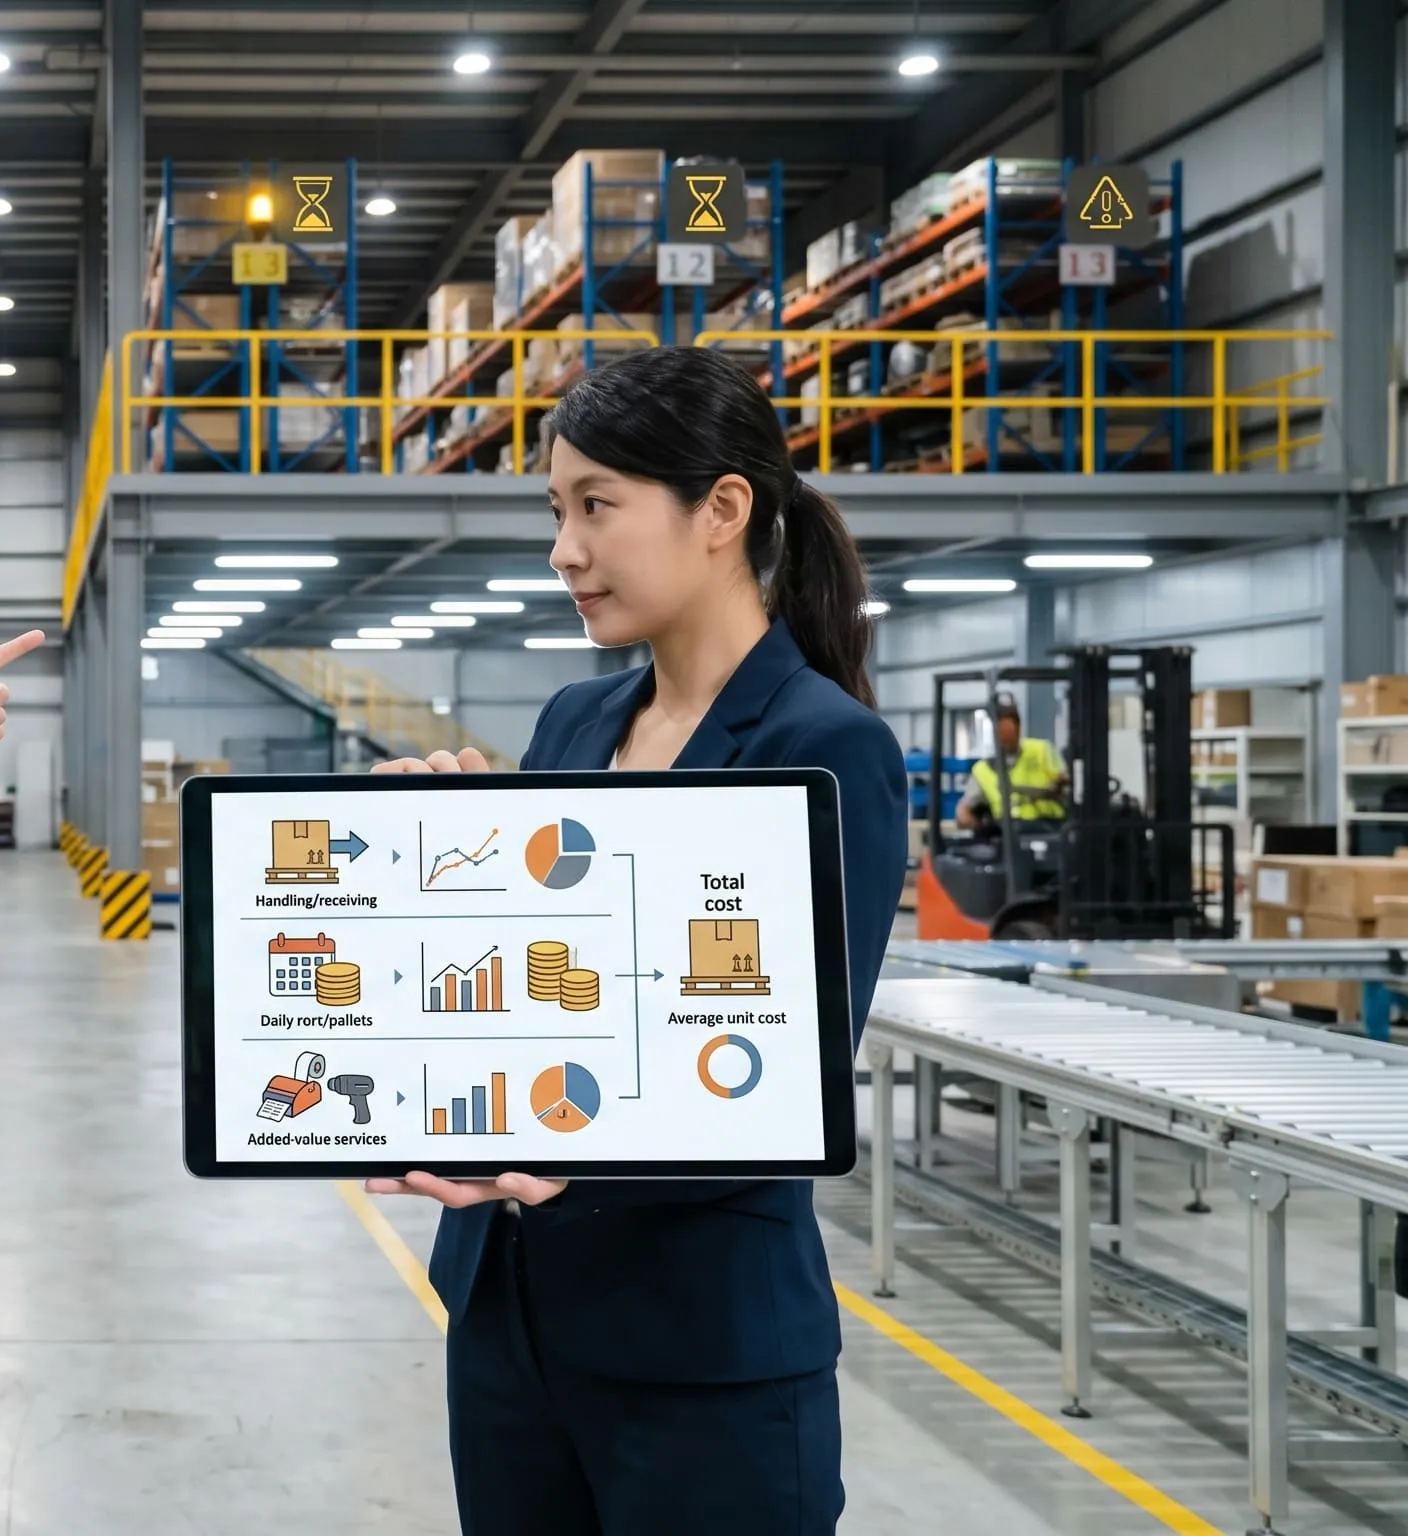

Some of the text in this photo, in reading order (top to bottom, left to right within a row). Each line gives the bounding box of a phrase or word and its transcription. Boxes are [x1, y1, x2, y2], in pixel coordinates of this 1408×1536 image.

[667, 251, 708, 278] 12
[1069, 251, 1107, 279] 13
[700, 872, 745, 890] Total
[255, 893, 378, 909] Handling/receiving
[704, 896, 743, 912] cost
[260, 1013, 373, 1030] Daily rort/pallets
[667, 1011, 787, 1028] Average unit cost
[247, 1132, 387, 1146] Added-value services
